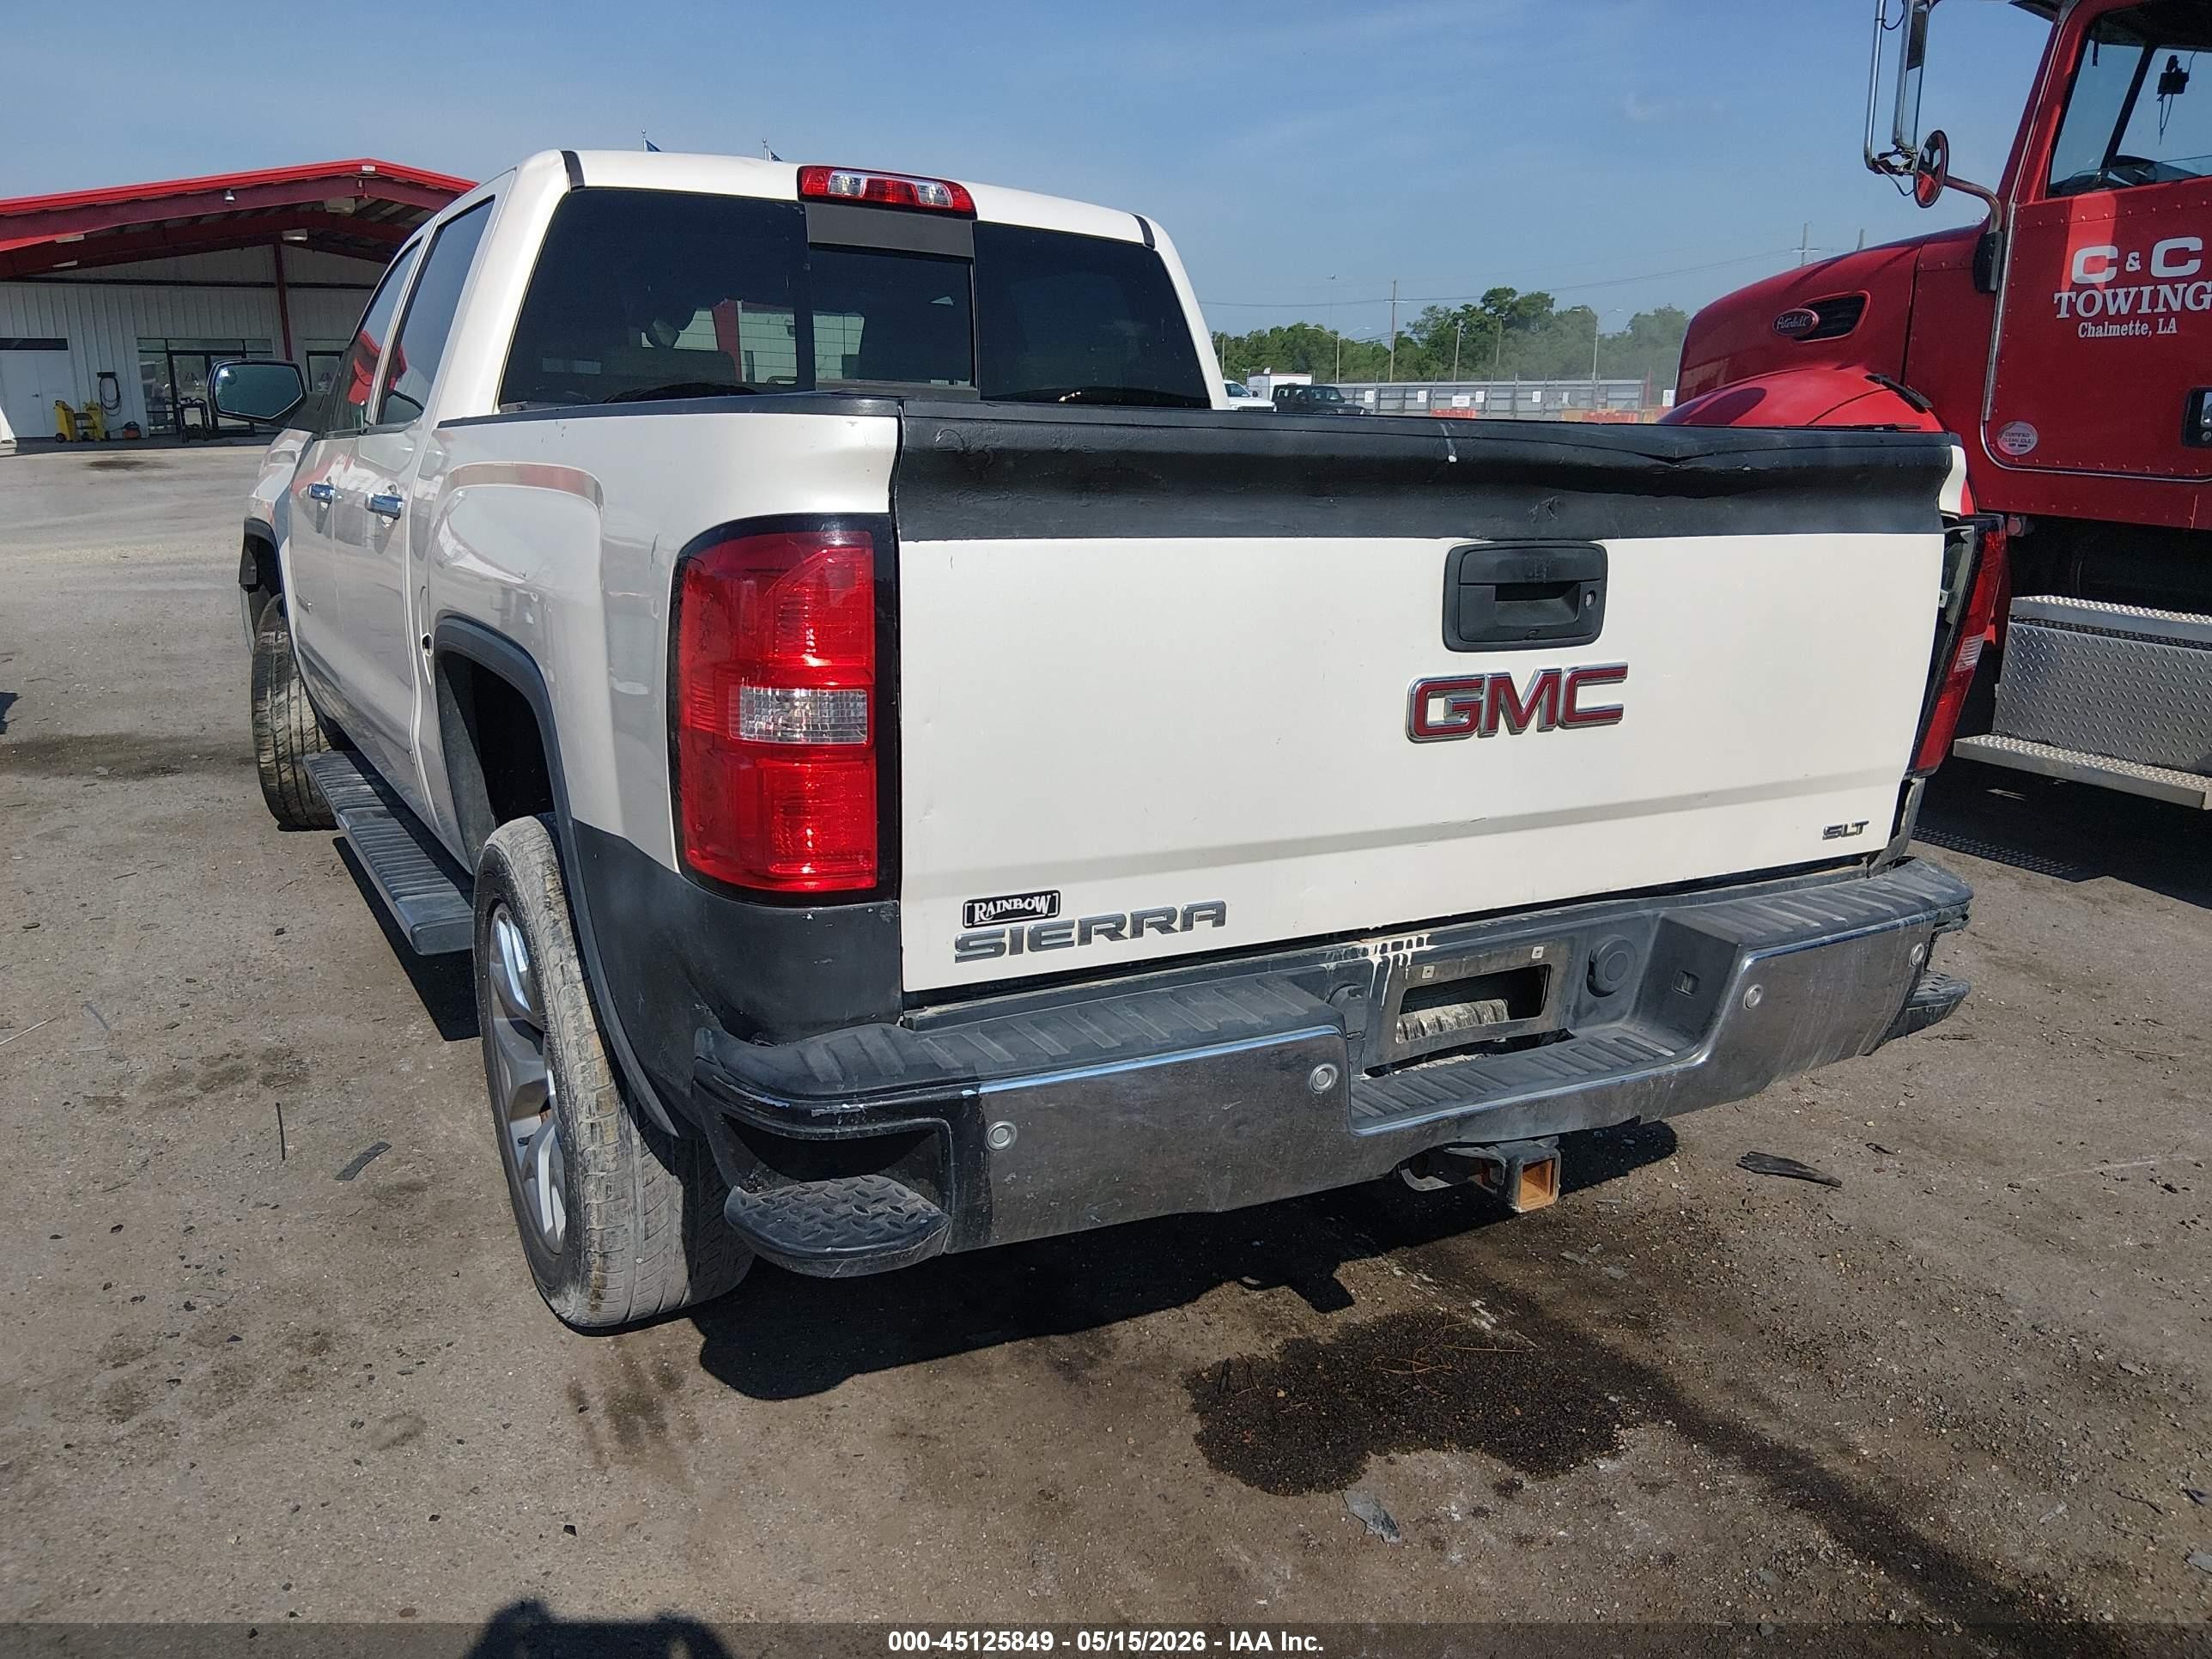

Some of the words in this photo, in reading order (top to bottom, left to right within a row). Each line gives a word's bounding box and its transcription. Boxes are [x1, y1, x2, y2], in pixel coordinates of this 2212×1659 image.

[2071, 245, 2118, 284] C
[2125, 252, 2141, 272] &
[2150, 236, 2203, 278] C
[2053, 281, 2212, 319] TOWING
[2078, 319, 2152, 338] Chalmette,
[2156, 317, 2178, 335] LA
[1406, 661, 1628, 744] GMC
[1822, 819, 1869, 841] SLT
[973, 893, 1052, 924] RAINBOW
[955, 900, 1227, 963] SIERRA
